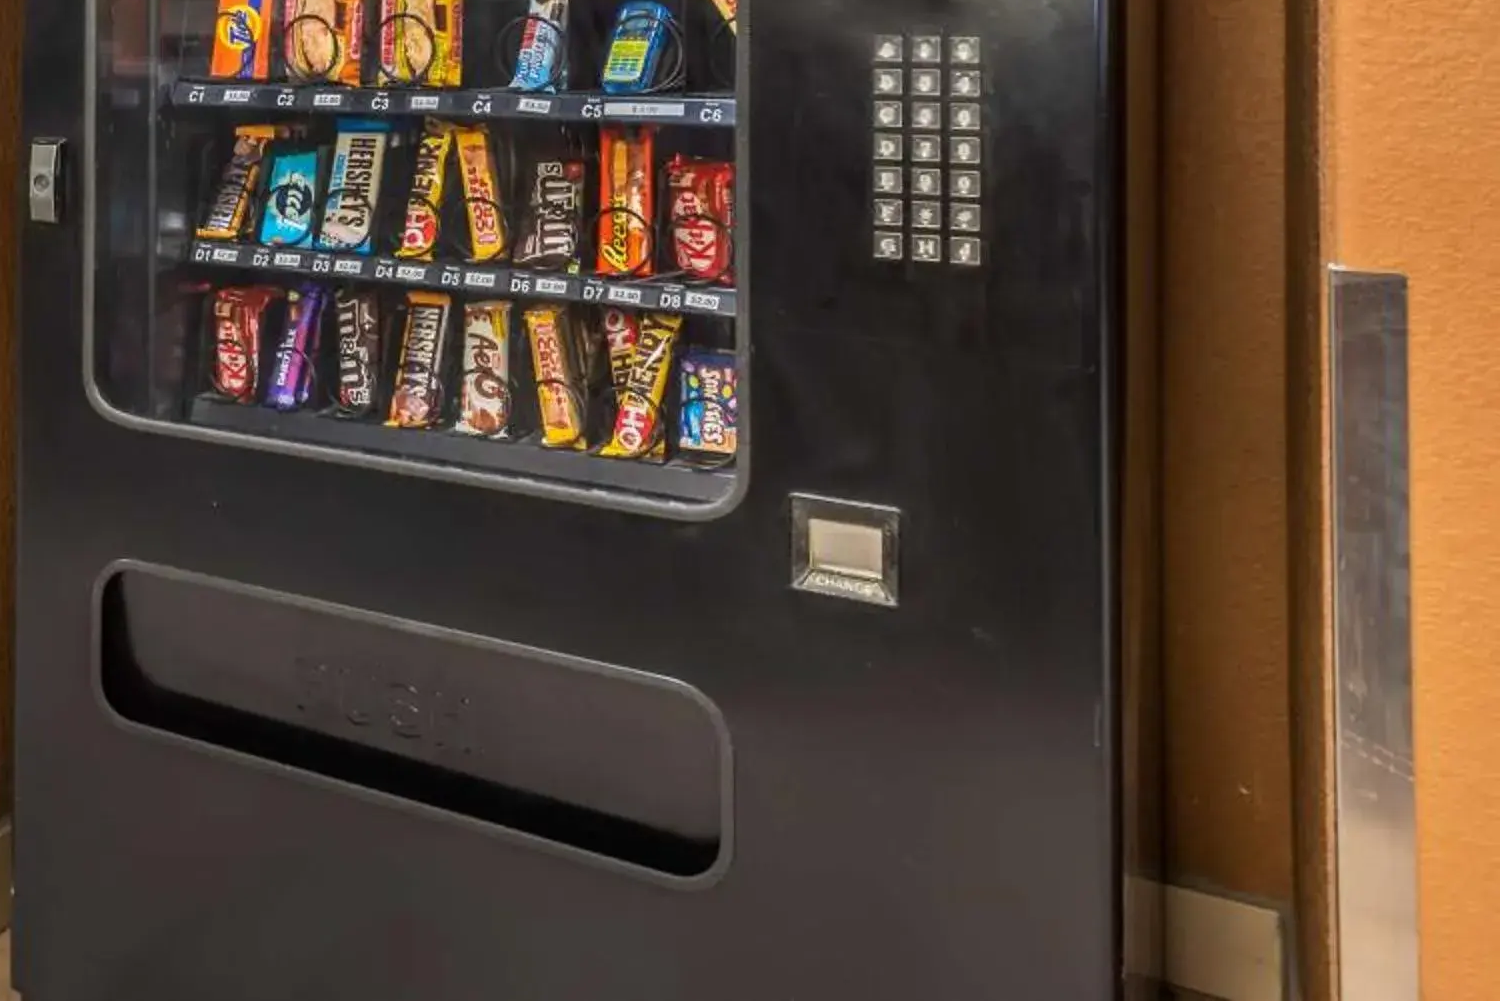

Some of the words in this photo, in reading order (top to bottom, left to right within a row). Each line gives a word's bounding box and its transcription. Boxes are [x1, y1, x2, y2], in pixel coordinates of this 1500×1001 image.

[188, 90, 205, 103] C1
[277, 94, 295, 106] C2
[371, 97, 389, 110] C3
[472, 101, 491, 113] C4
[581, 104, 603, 118] C5
[700, 108, 722, 122] C6
[337, 136, 377, 228] HERSHEY'S
[195, 248, 211, 262] D1
[252, 254, 269, 267] D2
[312, 260, 330, 272] D3
[375, 265, 393, 278] D4
[441, 272, 461, 286] D5
[510, 278, 530, 292] D6
[583, 286, 604, 300] D7
[660, 292, 681, 308] D8
